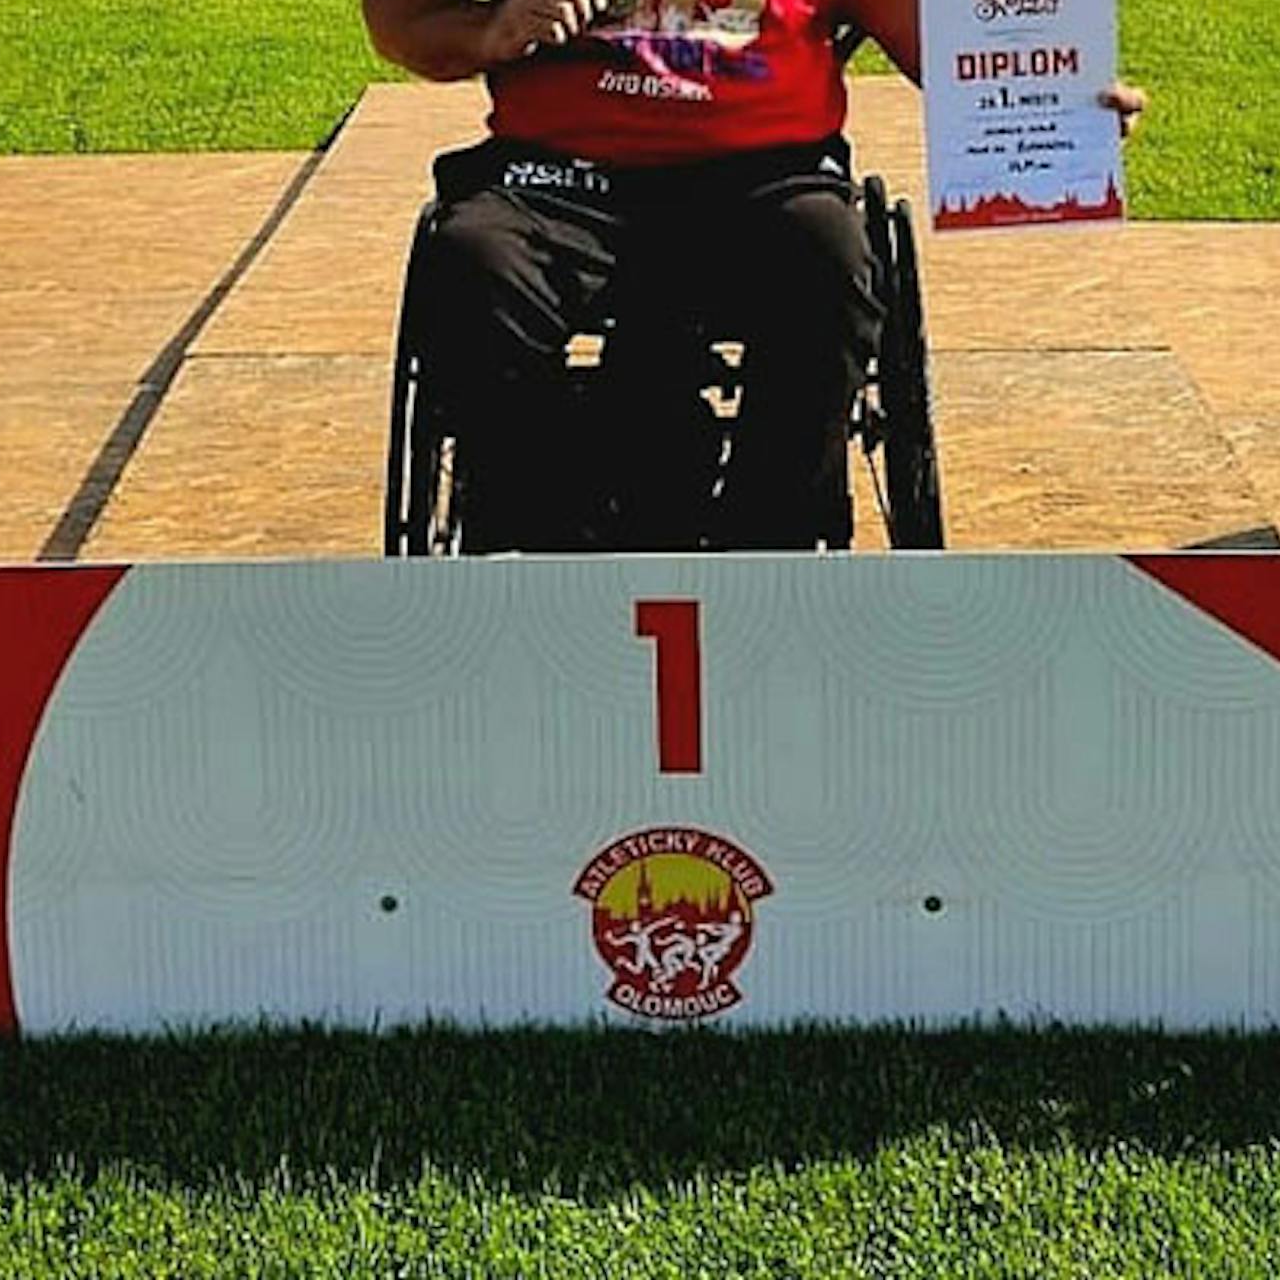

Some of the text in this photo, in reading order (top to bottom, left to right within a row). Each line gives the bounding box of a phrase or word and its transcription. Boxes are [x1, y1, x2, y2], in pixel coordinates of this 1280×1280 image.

[956, 47, 1078, 81] DIPLOM
[634, 600, 701, 774] 1
[616, 983, 734, 1017] OLOMOUC
